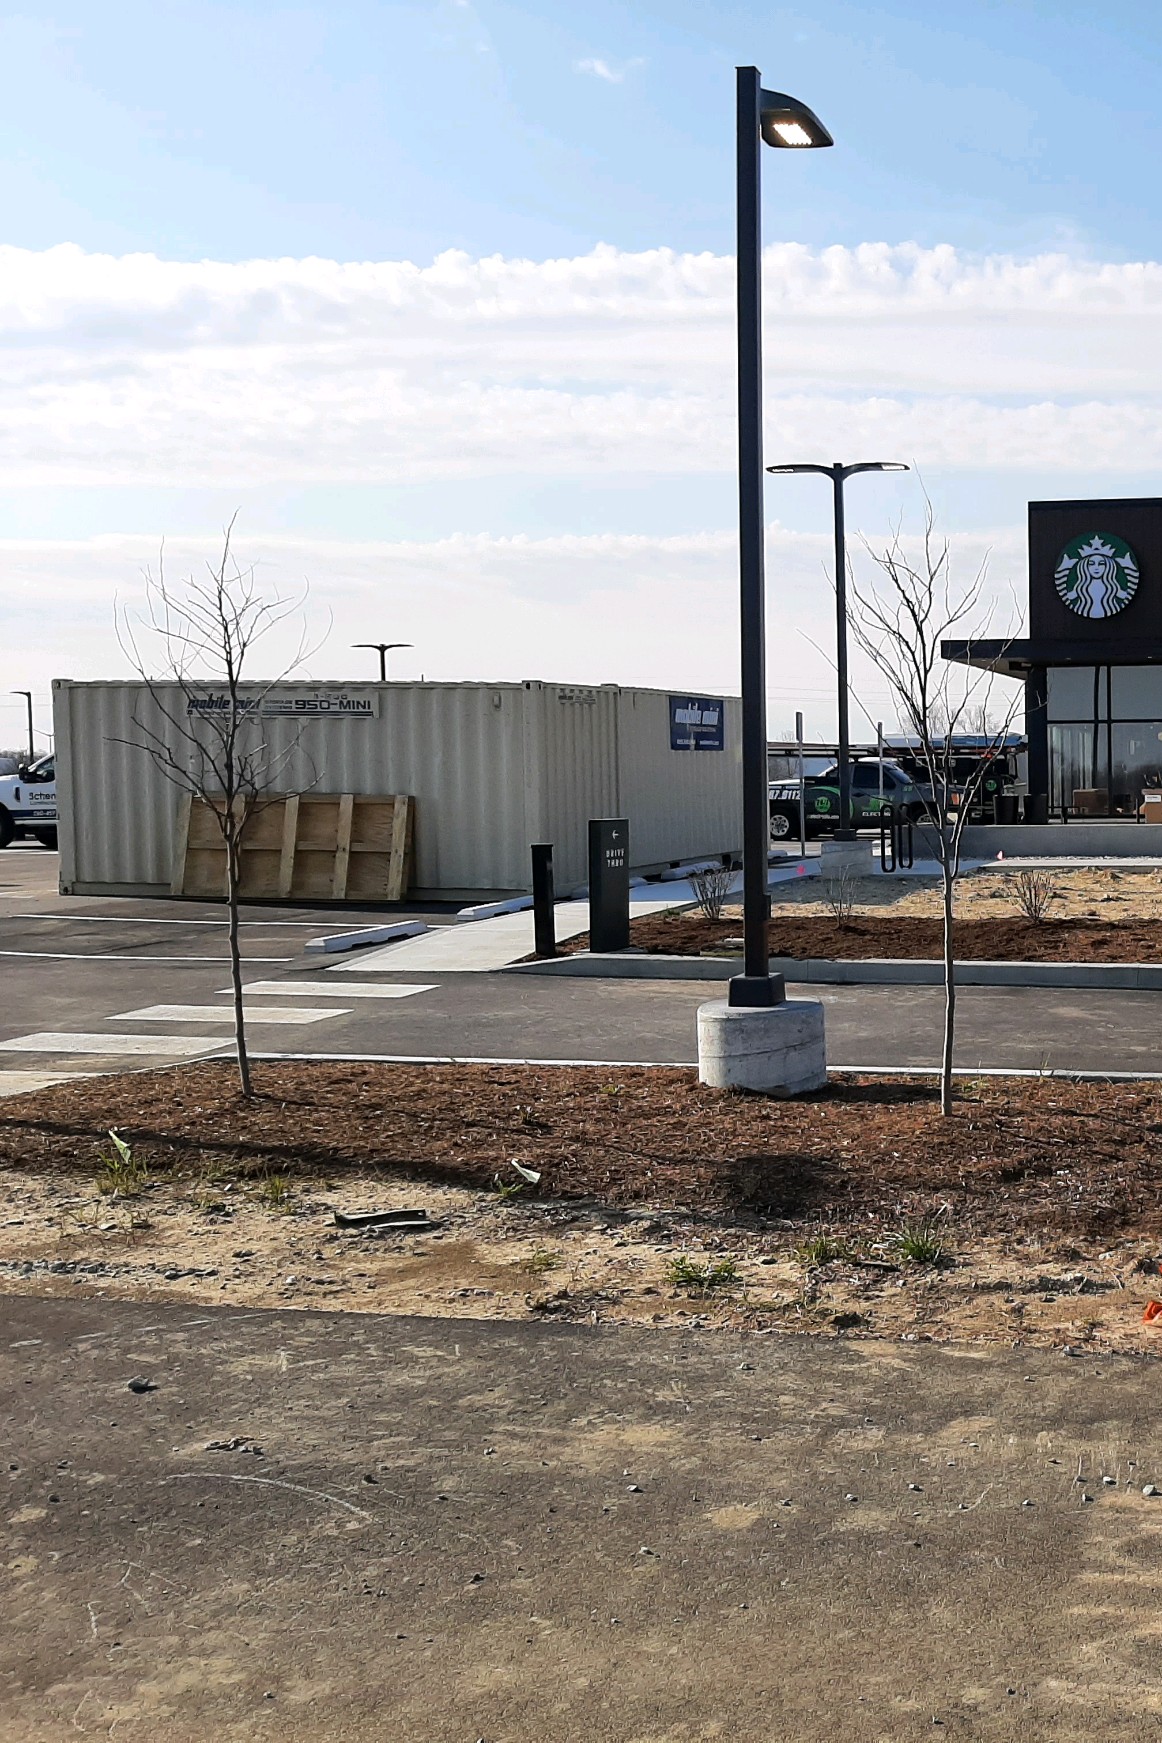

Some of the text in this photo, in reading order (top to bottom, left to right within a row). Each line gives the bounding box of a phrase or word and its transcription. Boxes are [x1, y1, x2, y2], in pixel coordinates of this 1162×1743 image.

[187, 693, 231, 709] mobile
[294, 699, 371, 710] 950-MINI
[605, 848, 624, 858] DRIVE
[607, 858, 624, 868] THRU
